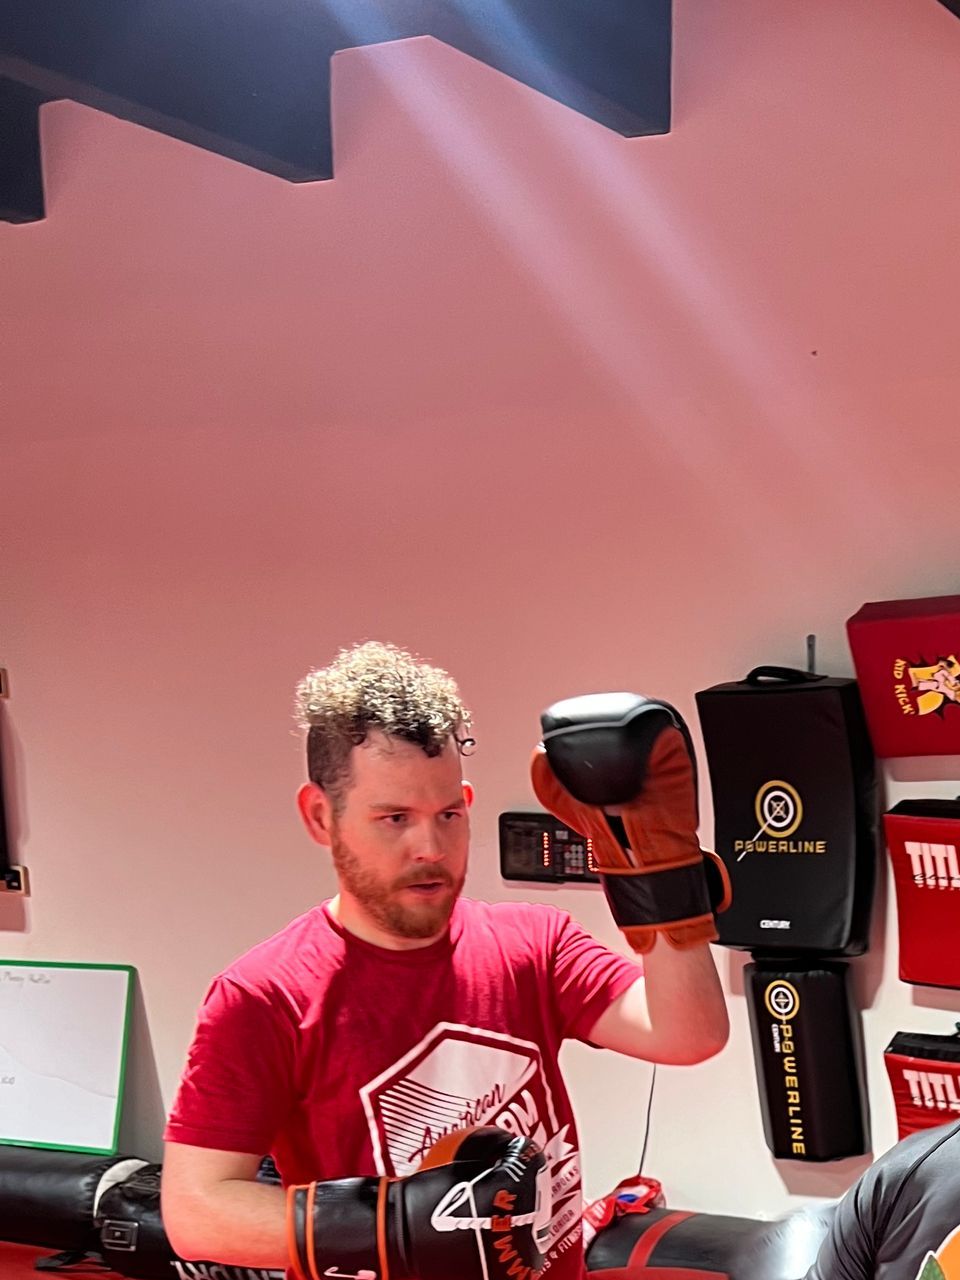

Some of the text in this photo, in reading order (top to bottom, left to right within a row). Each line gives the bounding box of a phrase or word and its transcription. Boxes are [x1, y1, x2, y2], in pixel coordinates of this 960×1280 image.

[894, 684, 914, 715] KICK
[734, 840, 828, 854] POWERLINE
[779, 1023, 807, 1156] POWERLINE
